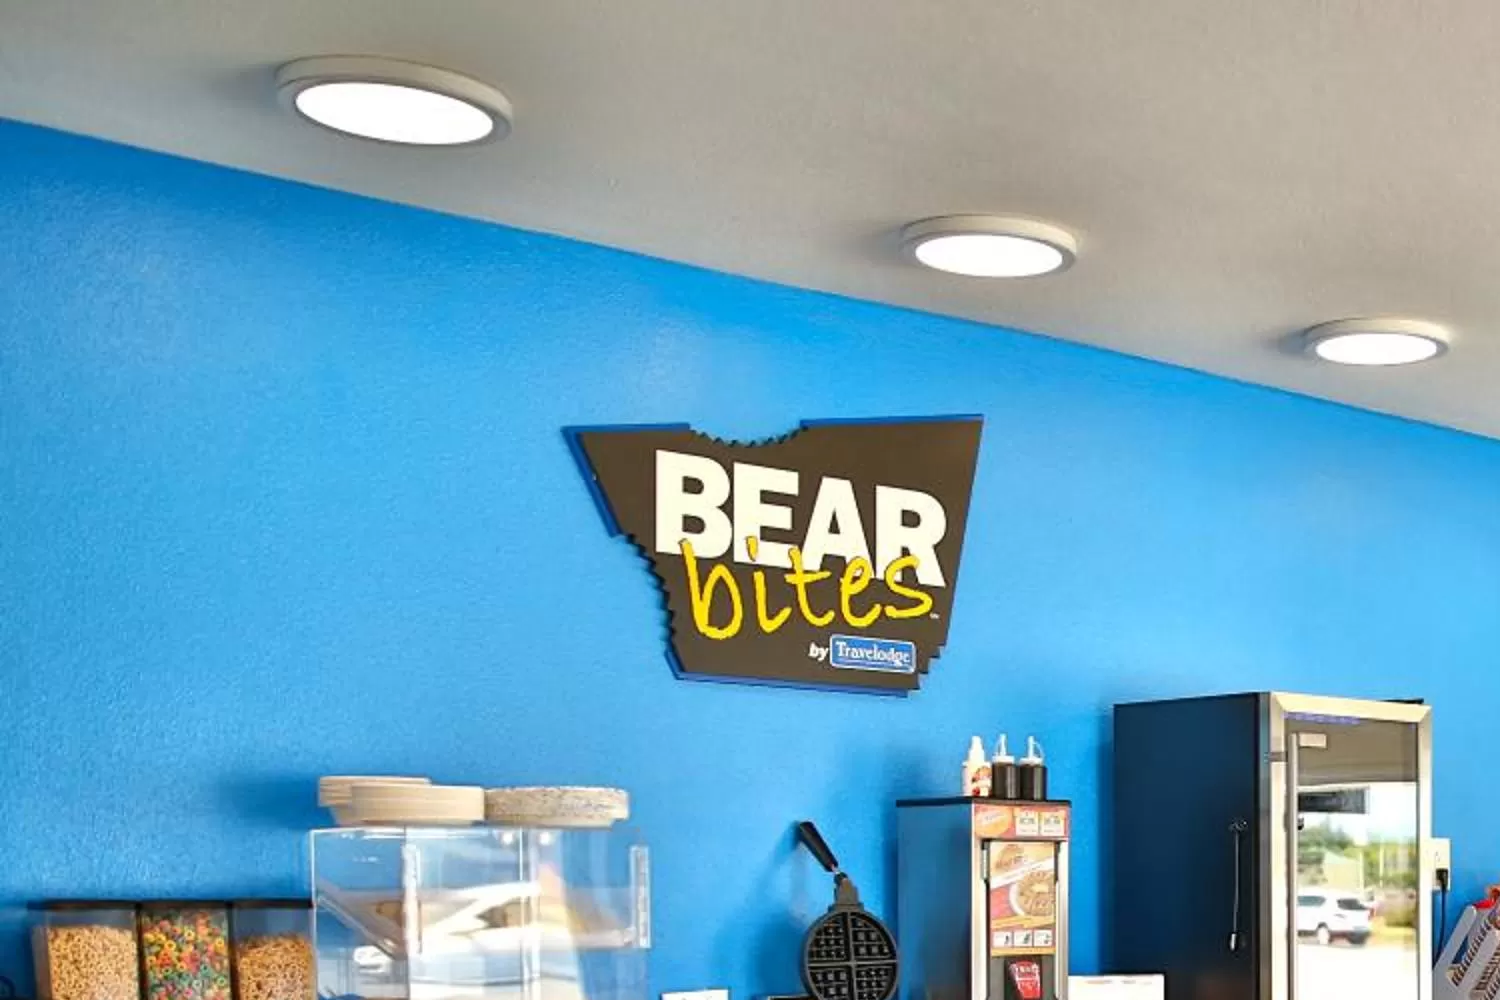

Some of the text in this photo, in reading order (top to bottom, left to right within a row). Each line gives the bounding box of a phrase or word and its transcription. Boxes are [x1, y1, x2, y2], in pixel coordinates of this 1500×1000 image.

[655, 449, 946, 588] BEAR
[679, 535, 934, 640] bites
[808, 641, 911, 667] by Travelodge
